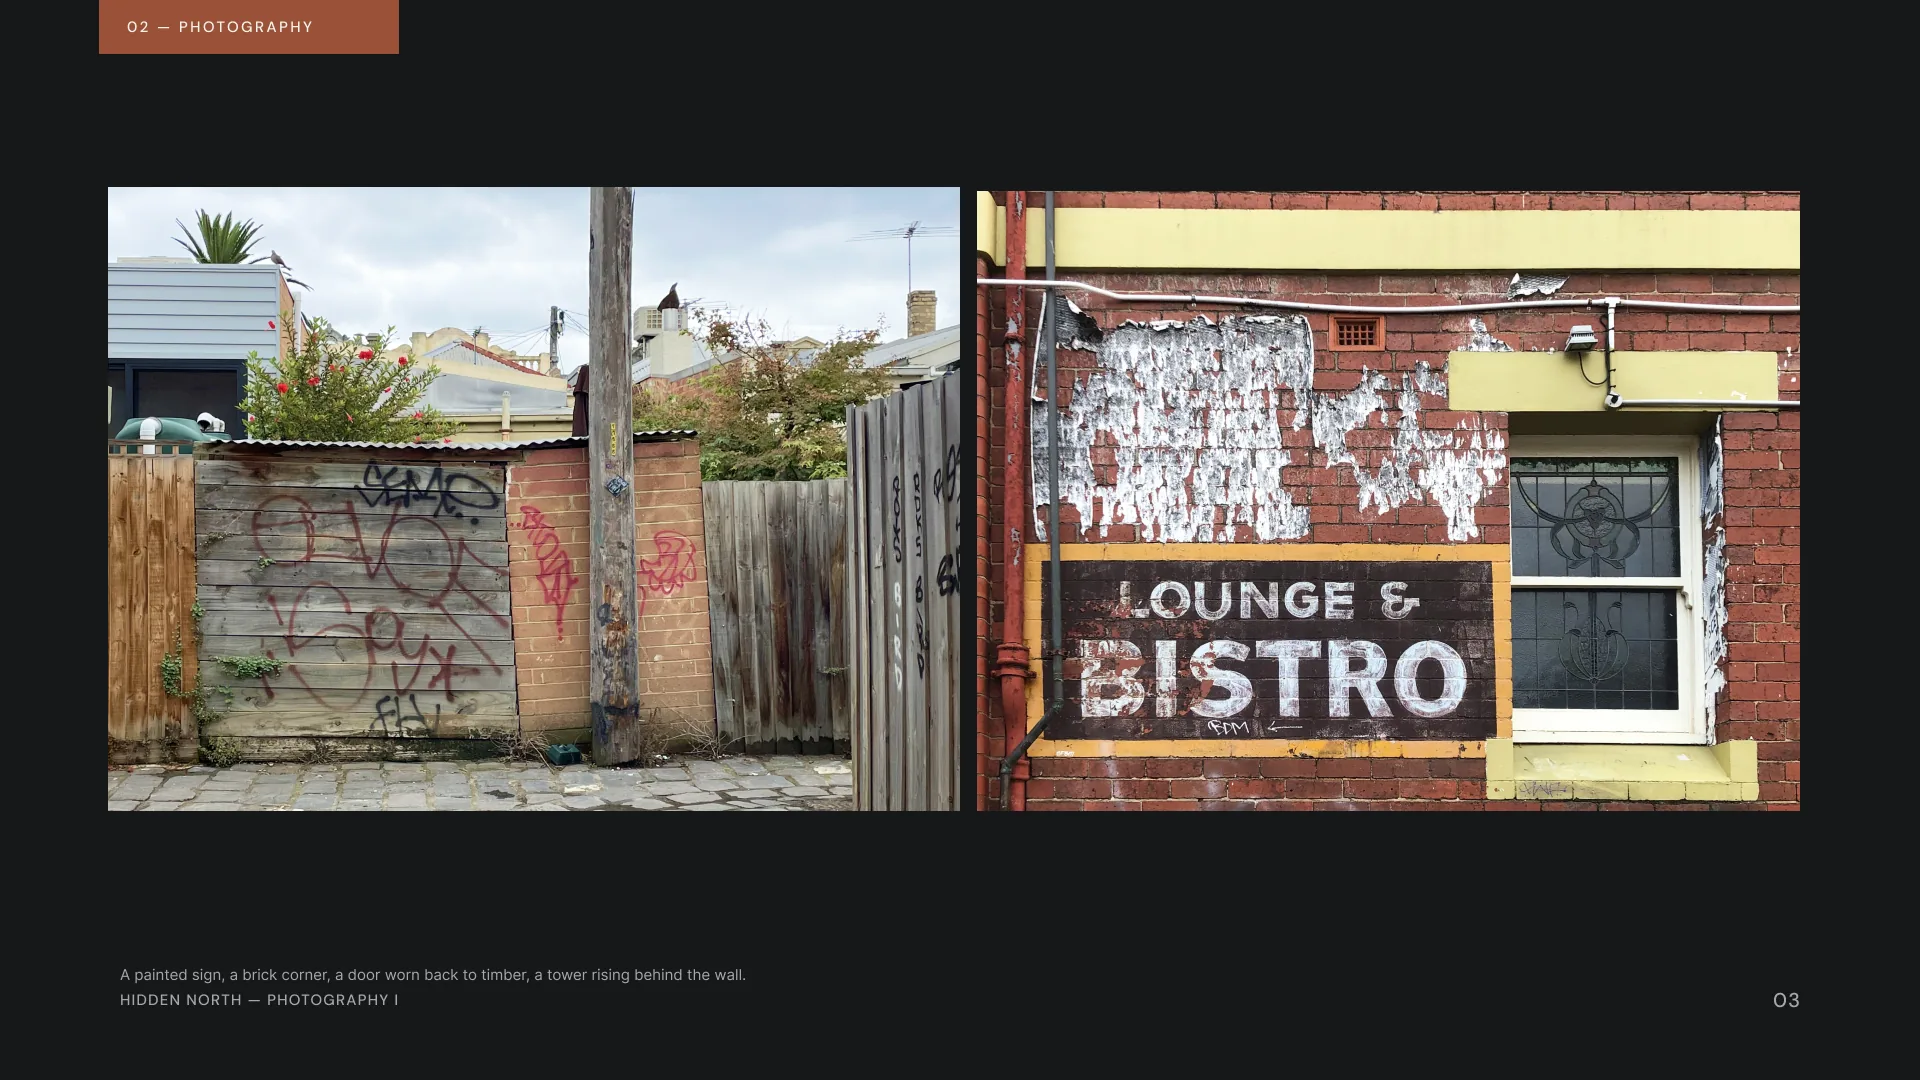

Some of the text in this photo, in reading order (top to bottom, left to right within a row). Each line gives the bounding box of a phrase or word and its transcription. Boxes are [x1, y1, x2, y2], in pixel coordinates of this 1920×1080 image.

[1118, 580, 1421, 621] LOUNGE &
[1079, 638, 1468, 719] BISTRO
